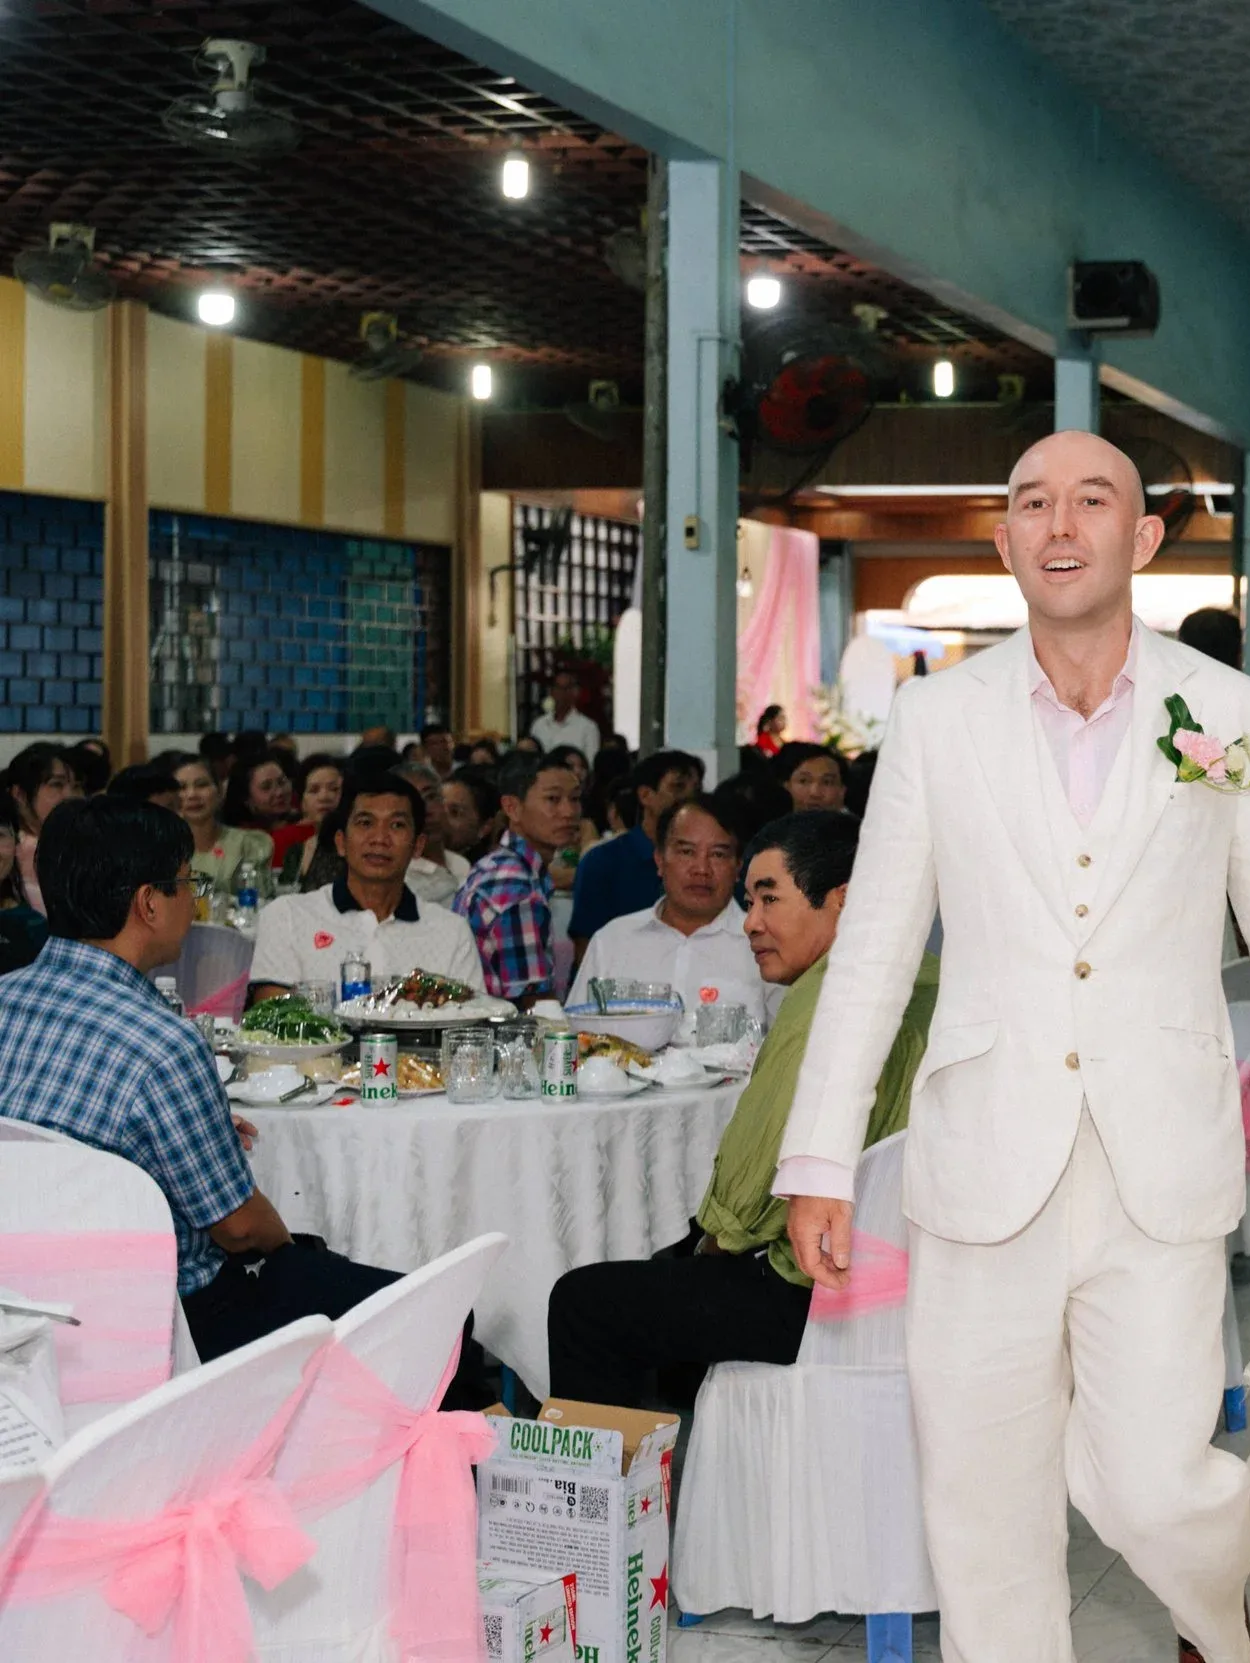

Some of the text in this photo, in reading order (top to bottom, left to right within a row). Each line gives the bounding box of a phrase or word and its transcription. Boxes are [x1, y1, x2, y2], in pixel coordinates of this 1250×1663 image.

[364, 1054, 373, 1080] SILVER
[510, 1421, 594, 1460] COOLPACK
[554, 1479, 576, 1495] Bia
